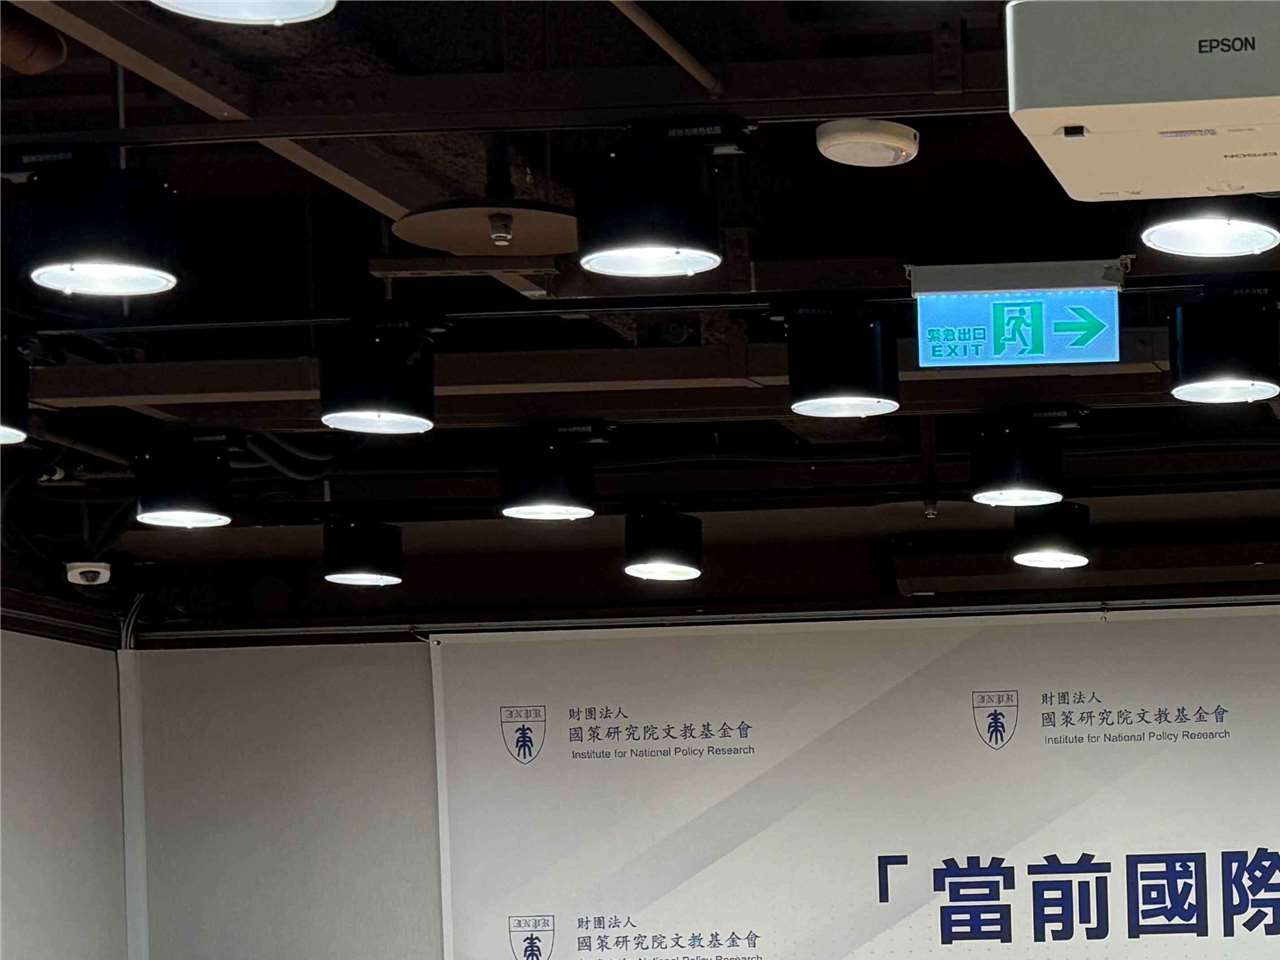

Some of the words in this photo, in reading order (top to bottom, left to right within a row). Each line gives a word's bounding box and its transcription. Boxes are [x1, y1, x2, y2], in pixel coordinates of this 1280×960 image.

[1198, 37, 1256, 54] EPSON
[928, 327, 986, 343] 緊急出口
[932, 344, 983, 358] EXIT
[1041, 691, 1102, 705] 財團法人
[568, 707, 629, 721] 財團法人
[1041, 704, 1229, 728] 國策研究院文教基金會
[568, 720, 753, 743] 國策研究院文教基金會
[1045, 734, 1084, 745] Institute
[1087, 733, 1101, 743] for
[1104, 732, 1145, 742] National
[1148, 731, 1179, 743] Policy
[1182, 729, 1231, 740] Research
[572, 749, 611, 759] Institute
[614, 748, 627, 758] for
[630, 747, 672, 757] National
[675, 746, 704, 759] Policy
[707, 745, 755, 755] Research
[577, 916, 637, 930] 財團法人
[577, 930, 761, 952] 國策研究院文教基金會
